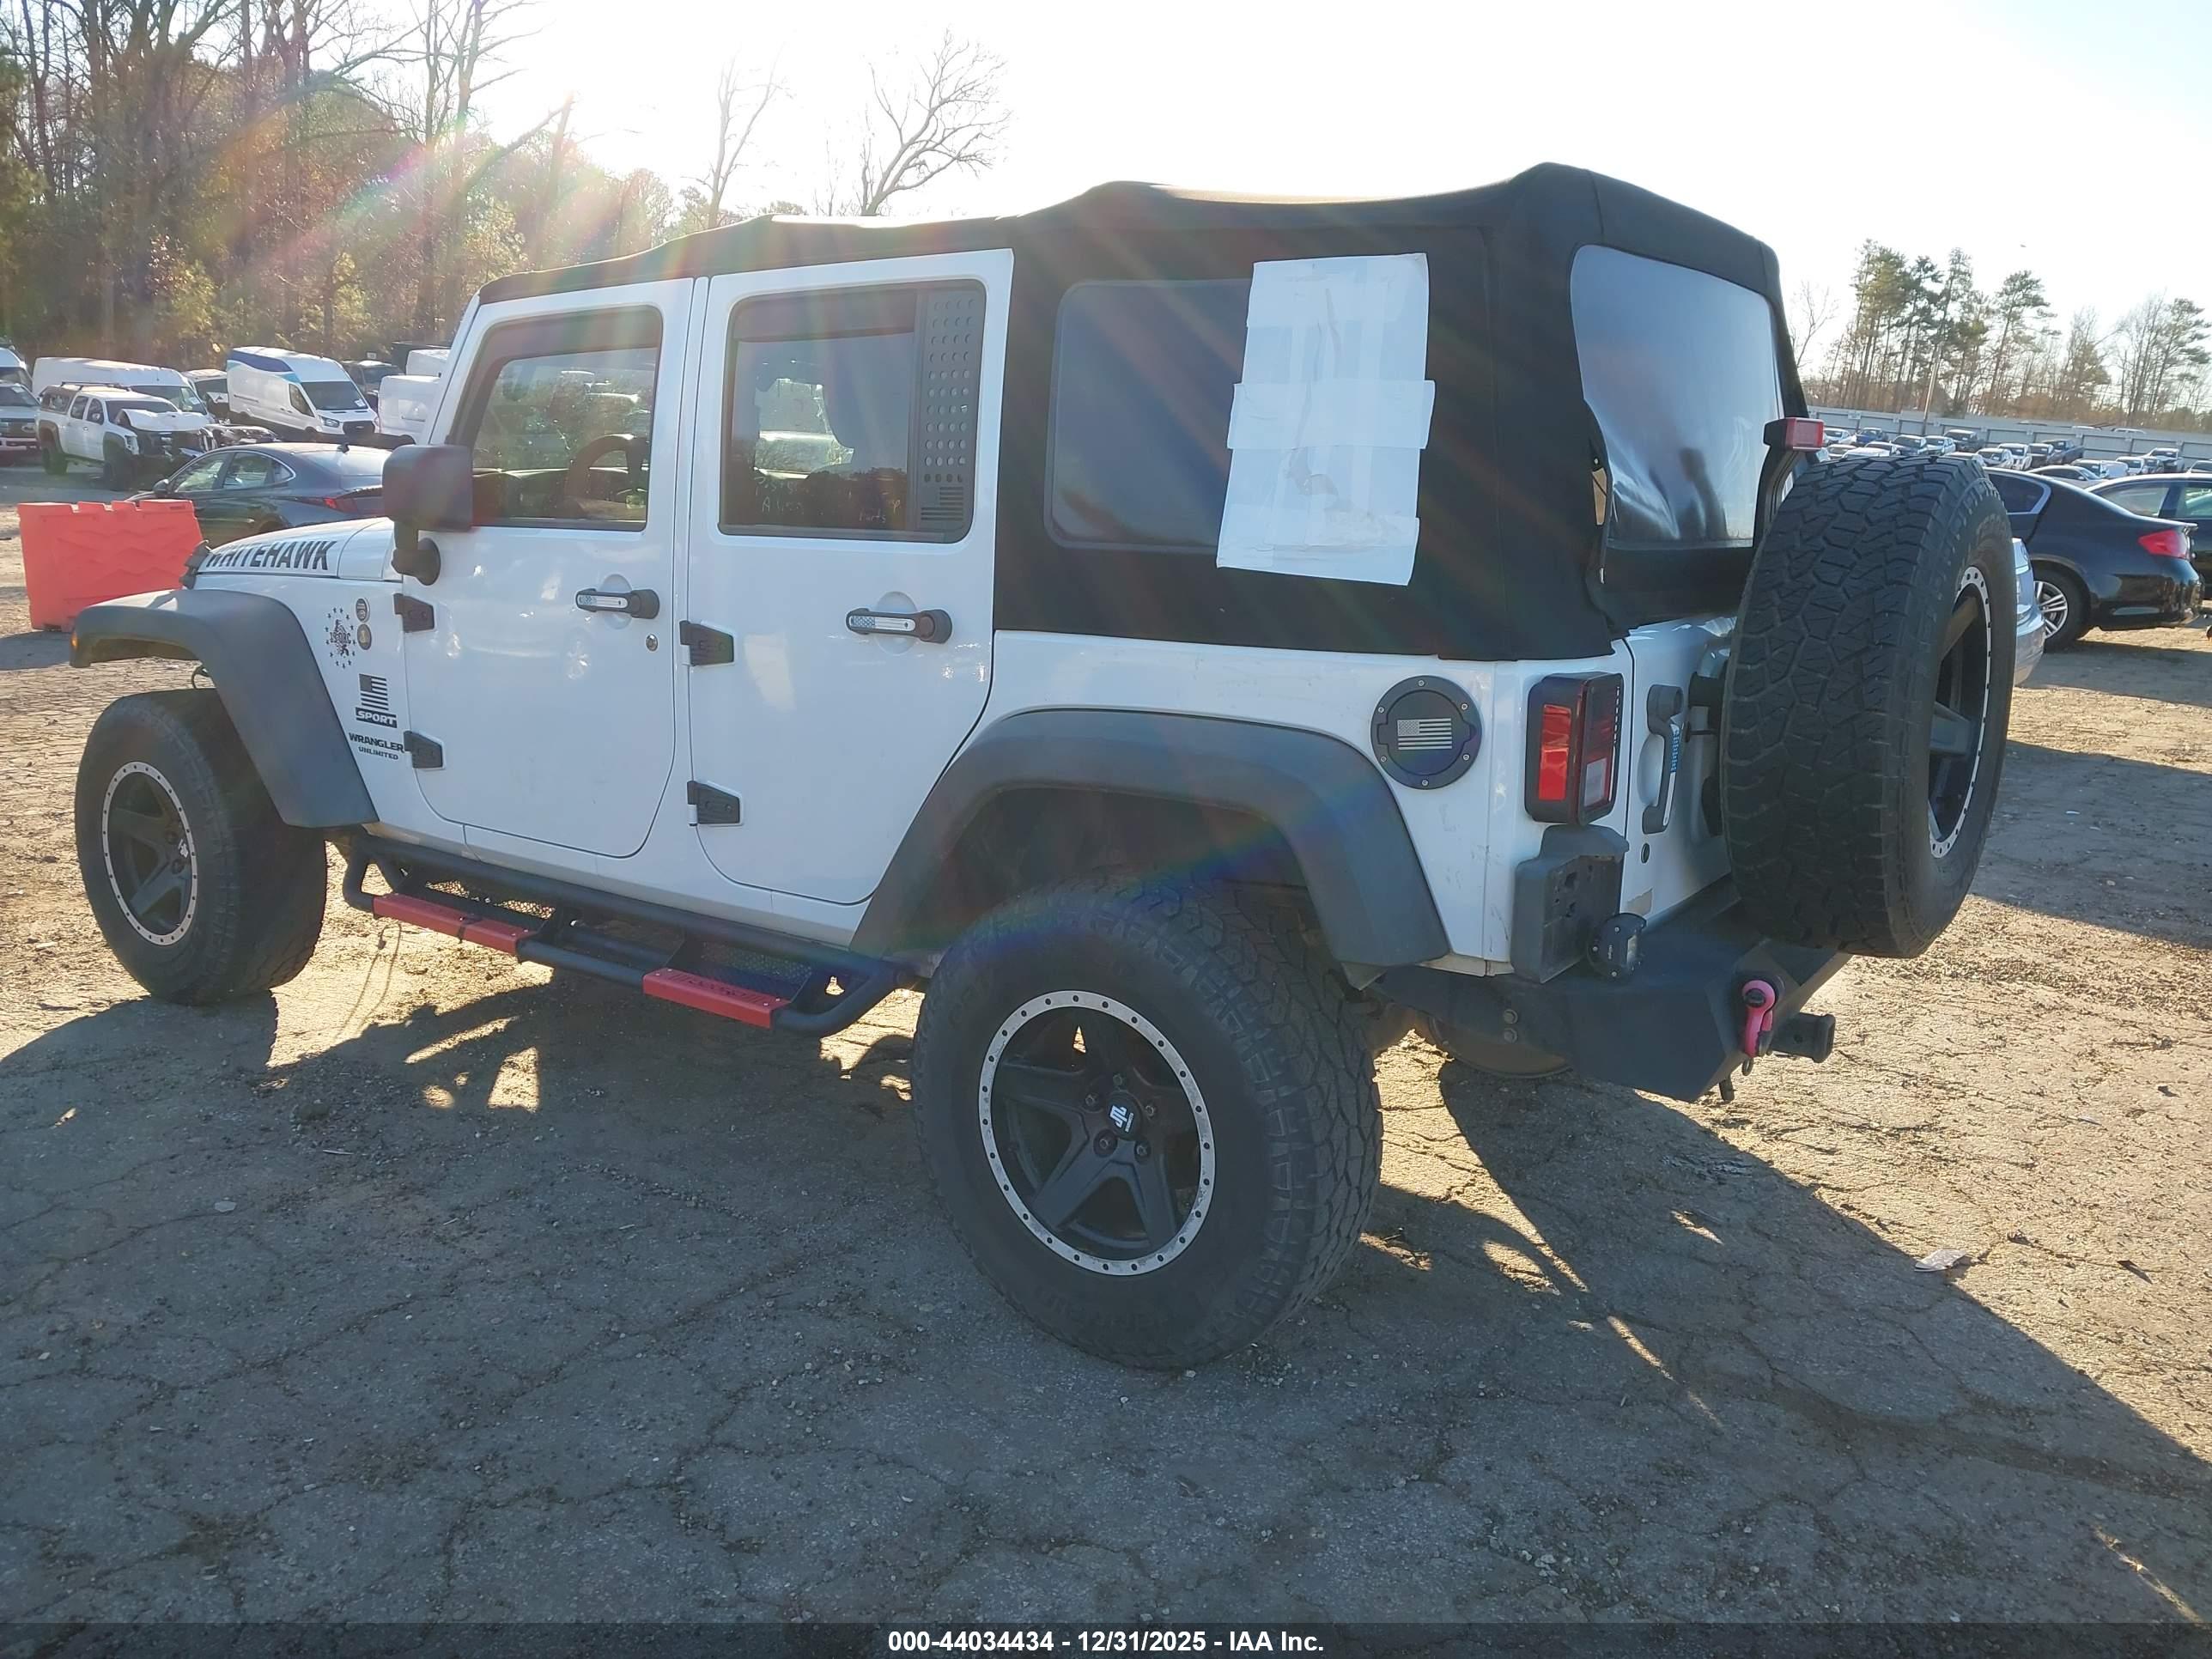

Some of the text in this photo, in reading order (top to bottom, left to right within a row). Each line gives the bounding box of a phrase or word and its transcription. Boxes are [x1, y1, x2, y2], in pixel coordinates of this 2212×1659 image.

[205, 540, 337, 571] WHITEHAWK
[357, 710, 397, 726] SPORT
[349, 732, 404, 752] WRANGLER
[358, 746, 399, 761] UNLIMITED
